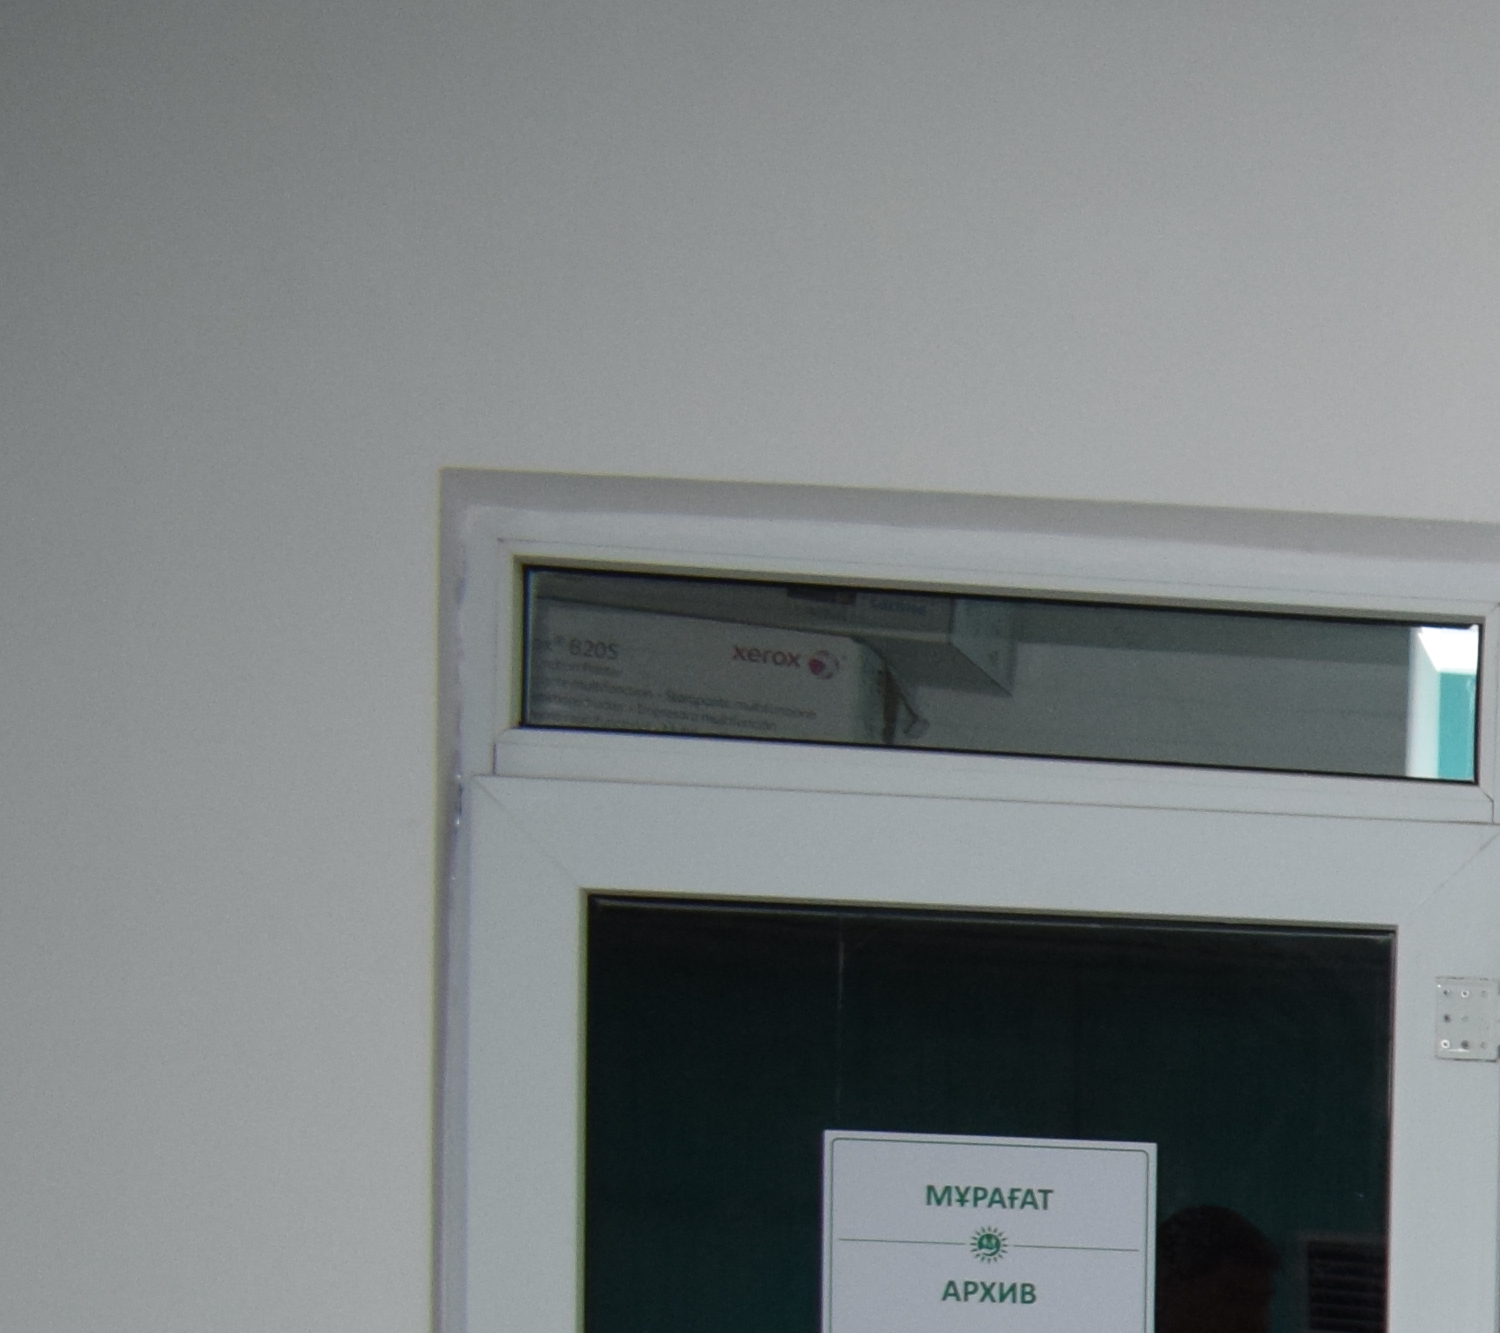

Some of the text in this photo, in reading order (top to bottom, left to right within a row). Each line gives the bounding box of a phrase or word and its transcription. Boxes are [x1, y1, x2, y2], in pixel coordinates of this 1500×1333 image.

[731, 644, 801, 668] xerox
[925, 1184, 1054, 1211] МҰРАҒАТ
[942, 1279, 1037, 1305] АРХИВ
